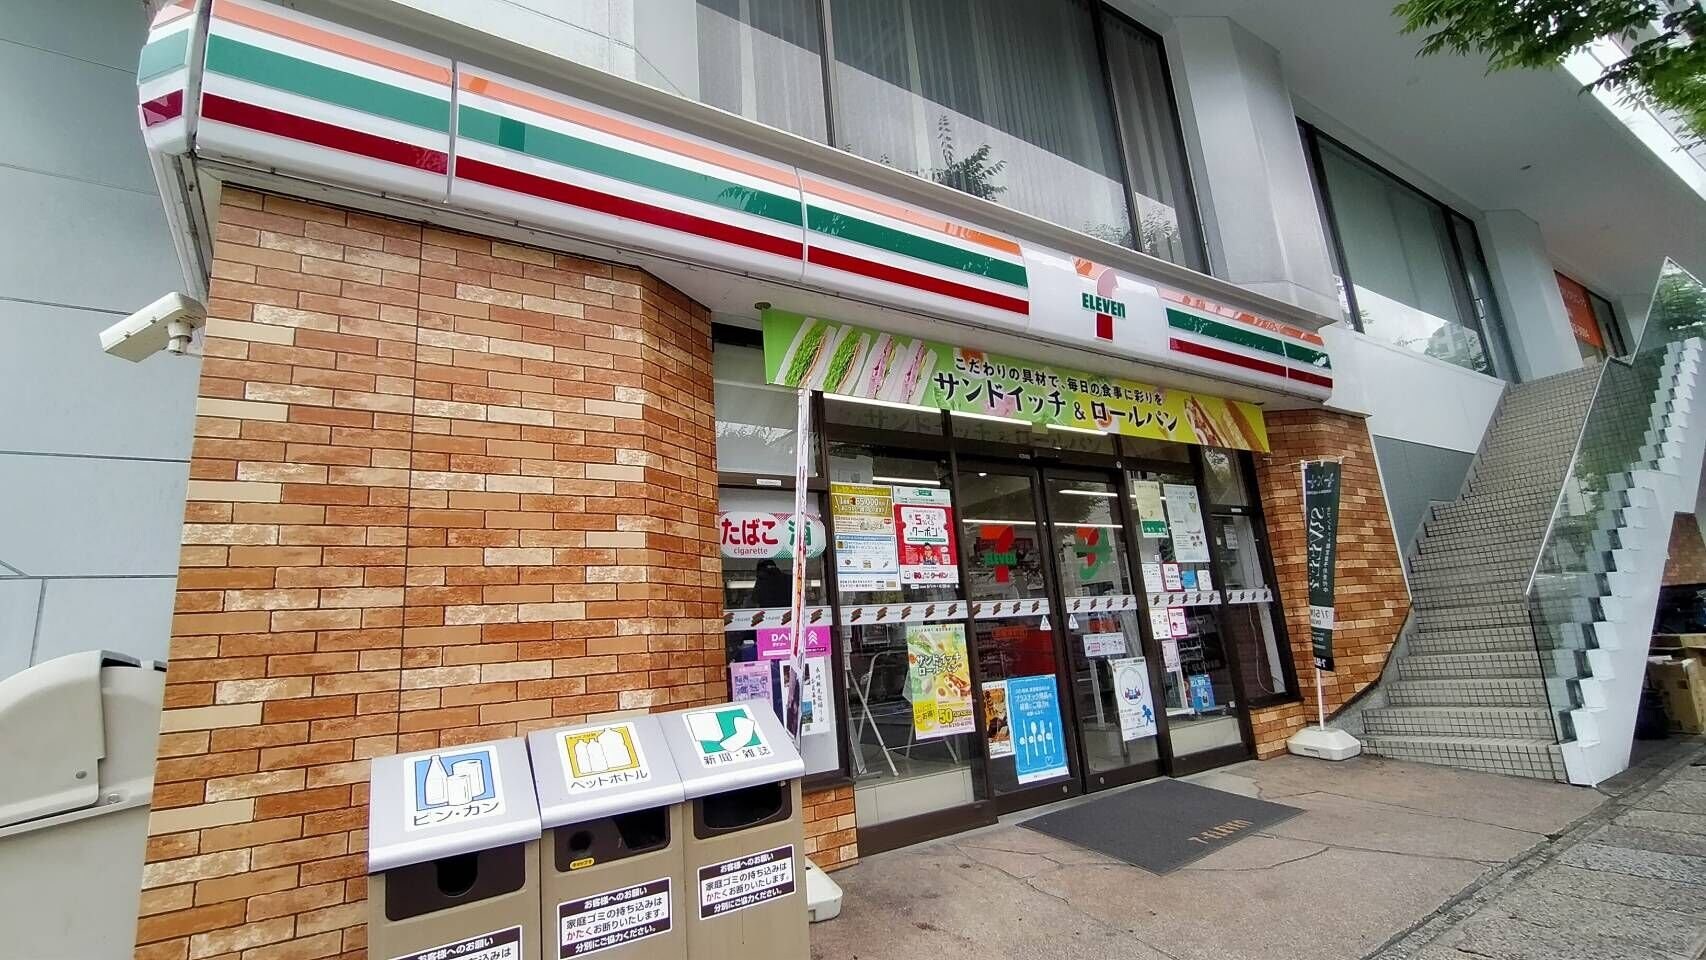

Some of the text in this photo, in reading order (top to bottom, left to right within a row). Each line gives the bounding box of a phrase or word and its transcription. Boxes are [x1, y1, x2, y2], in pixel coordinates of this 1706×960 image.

[955, 357, 1164, 406] こだわりの具材で、毎日の食事に彩りを
[934, 372, 1178, 432] サンドイッチ & ロールパン
[721, 518, 778, 545] たばこ
[733, 547, 768, 555] cigarette
[705, 862, 787, 892] 家庭ゴミの持ち込みは
[706, 873, 789, 903] かたくお断りいたします。
[584, 886, 648, 909] お客様へのお願い
[566, 896, 663, 930] 家庭ゴミの持ち込みは
[567, 908, 666, 942] かたくお断りいたします。
[575, 924, 657, 954] 分別にご協力ください。
